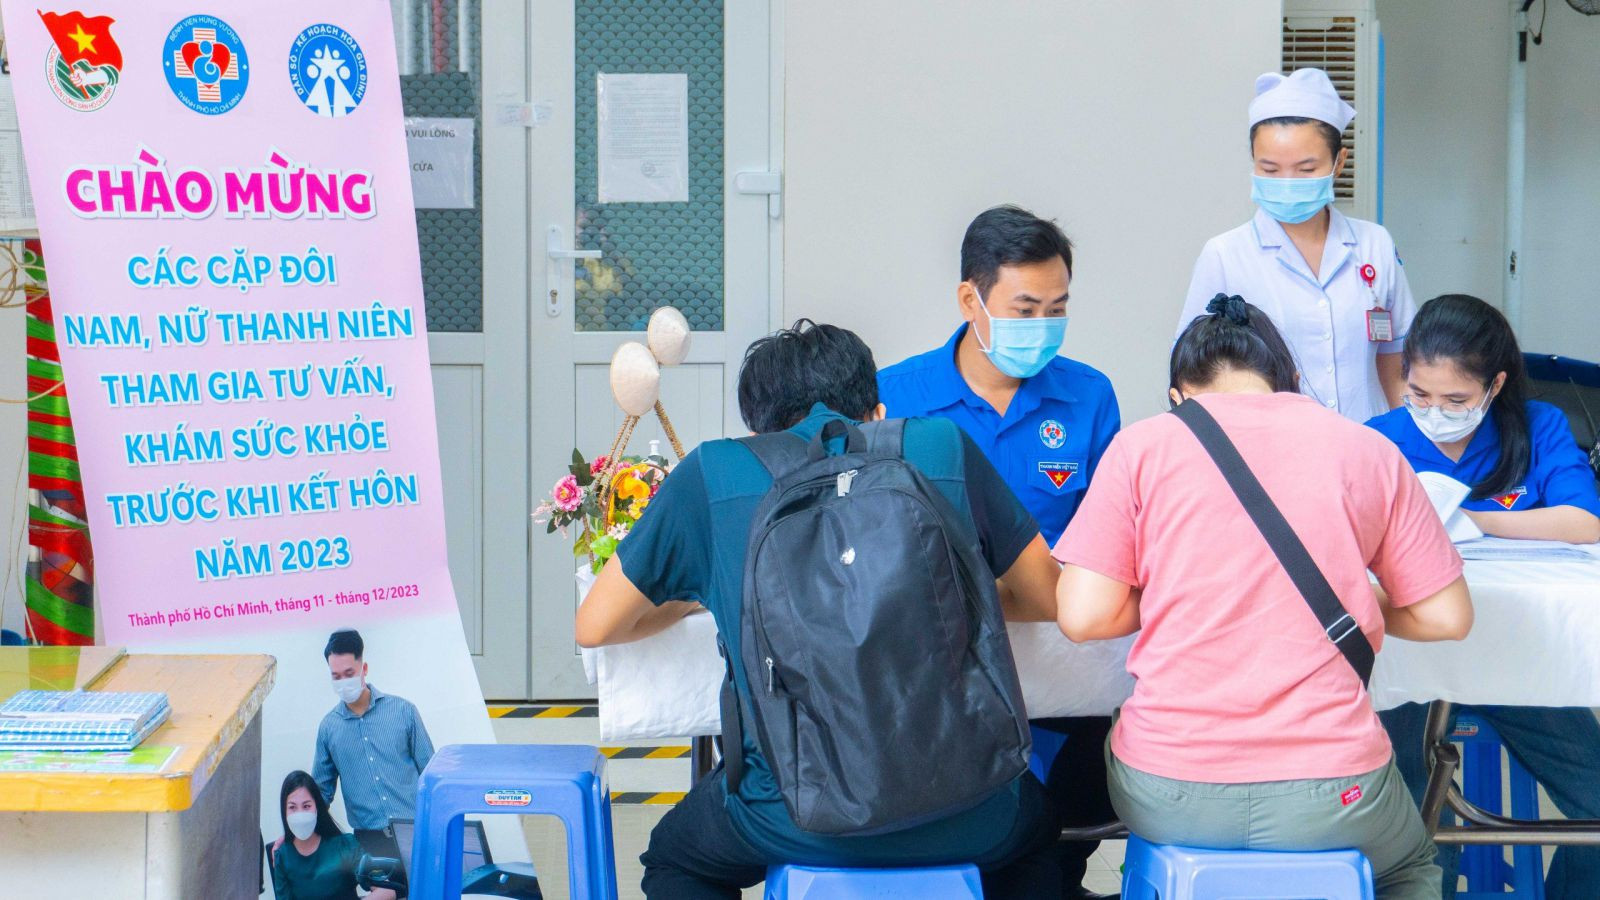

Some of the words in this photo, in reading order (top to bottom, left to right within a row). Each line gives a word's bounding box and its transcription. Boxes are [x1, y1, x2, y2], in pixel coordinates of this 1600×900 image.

[356, 52, 366, 71] GIA
[411, 130, 427, 138] VUI
[430, 128, 455, 138] LÒNG
[65, 149, 214, 214] CHÀO
[224, 151, 372, 215] MỪNG
[127, 247, 199, 286] CÁC
[206, 248, 272, 291] CẶP
[279, 247, 336, 284] ĐÔI
[63, 315, 150, 350] NAM,
[158, 306, 209, 345] NỮ
[215, 311, 330, 343] THANH
[337, 301, 413, 339] NIÊN
[100, 372, 200, 405] THAM
[207, 370, 264, 401] GIA
[268, 364, 313, 398] TƯ
[317, 357, 393, 398] VẤN,
[124, 423, 224, 465] KHÁM
[231, 419, 298, 459] SỨC
[303, 414, 388, 454] KHỎE
[106, 482, 219, 526] TRƯỚC
[225, 484, 281, 518] KHI
[287, 471, 341, 513] KẾT
[348, 468, 417, 508] HÔN
[194, 539, 272, 580] NĂM
[279, 536, 351, 572] 2023
[128, 611, 166, 627] Thành
[168, 607, 192, 626] phố
[193, 605, 212, 621] Hồ
[214, 601, 235, 618] Chí
[237, 600, 273, 616] Minh,
[275, 597, 312, 613] tháng
[313, 594, 325, 608] 11
[335, 590, 371, 607] tháng
[371, 584, 420, 602] 12/2023
